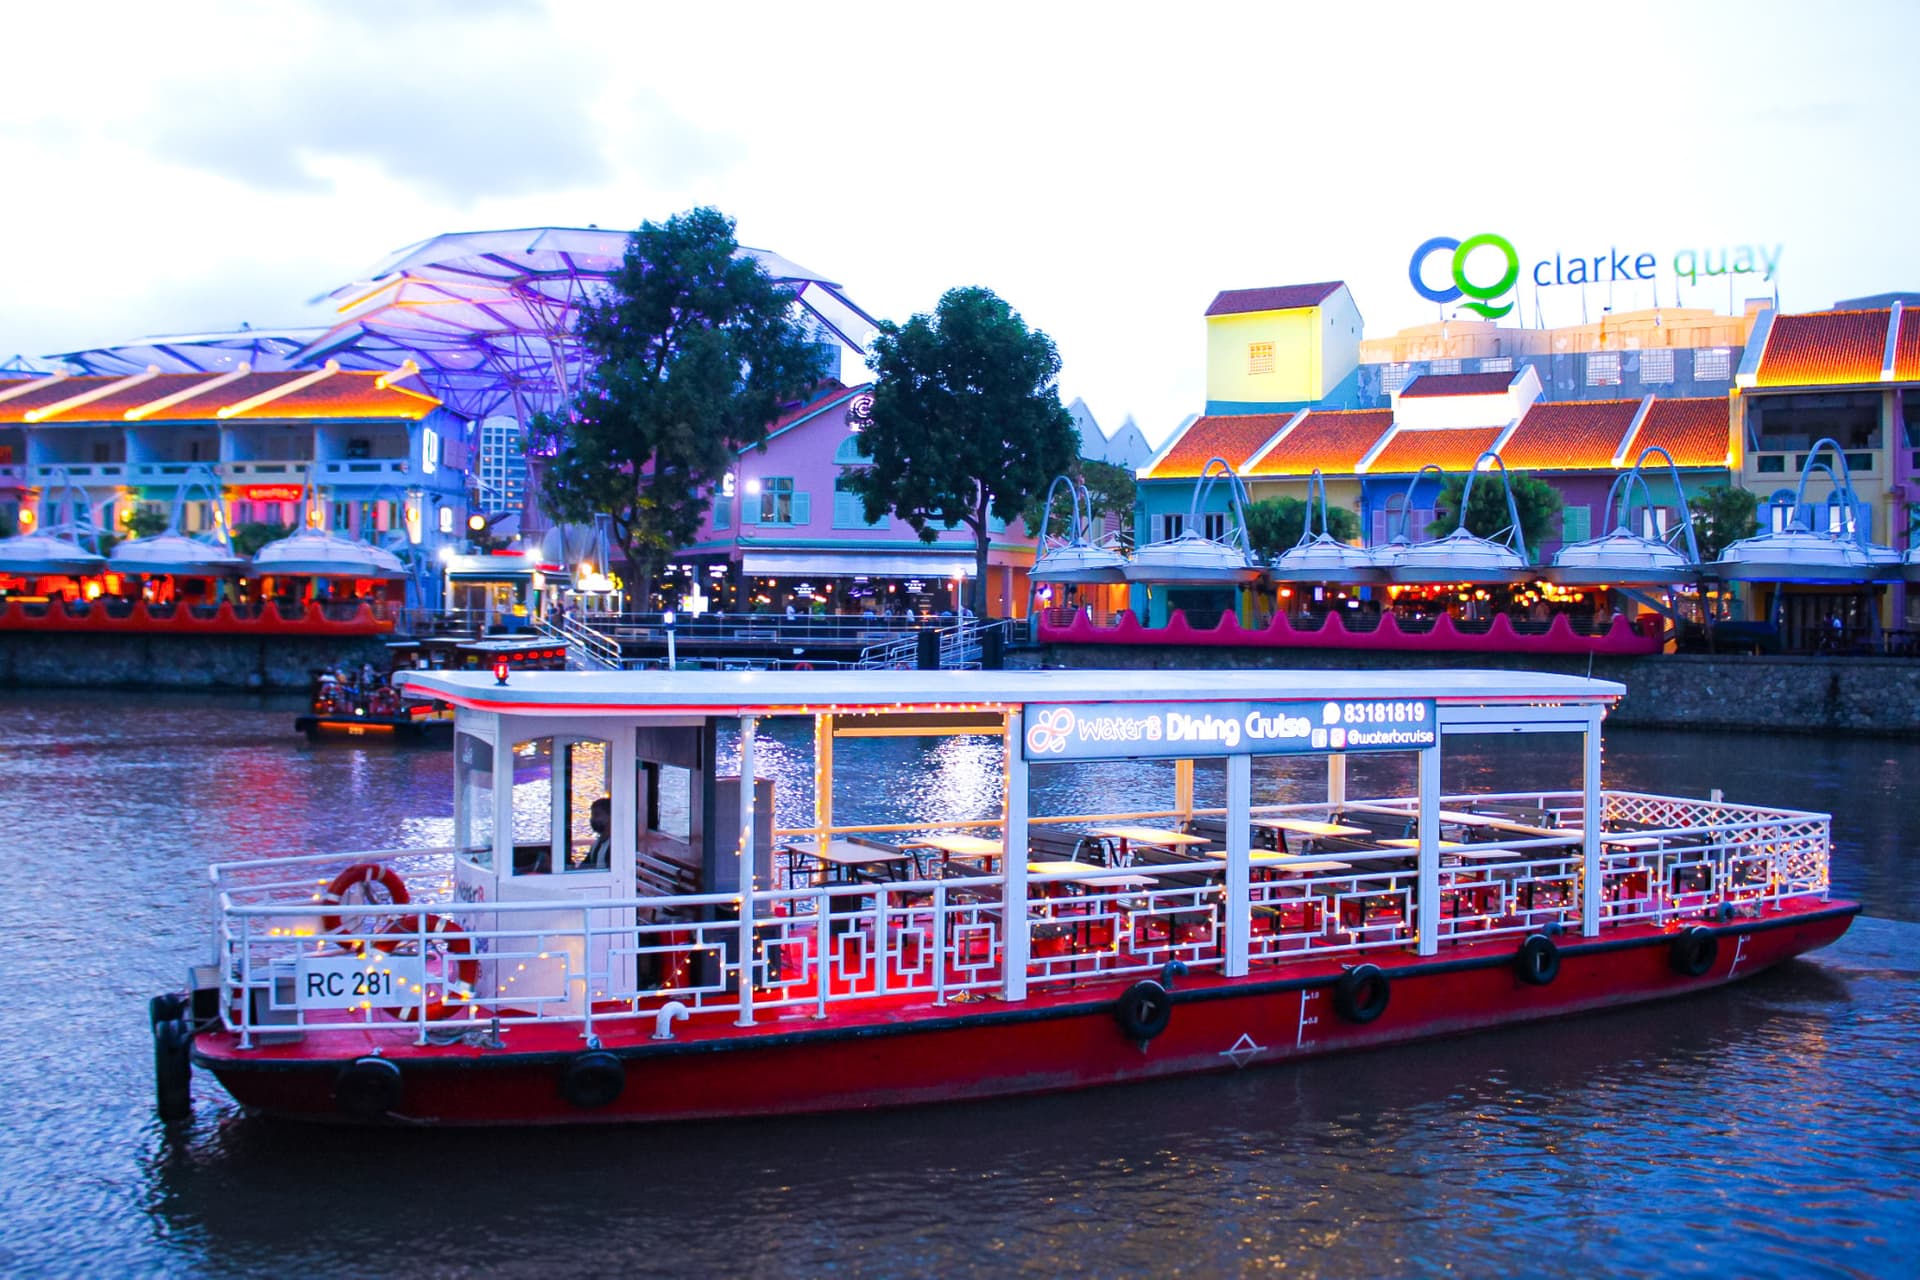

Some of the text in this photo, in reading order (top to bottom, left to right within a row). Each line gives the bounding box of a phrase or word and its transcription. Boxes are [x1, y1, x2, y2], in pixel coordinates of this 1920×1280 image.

[1533, 243, 1784, 287] clarke quay
[1344, 702, 1425, 723] 83181819
[1166, 712, 1241, 747] Dining
[1245, 711, 1312, 739] Cruise
[307, 971, 392, 998] RC 281
